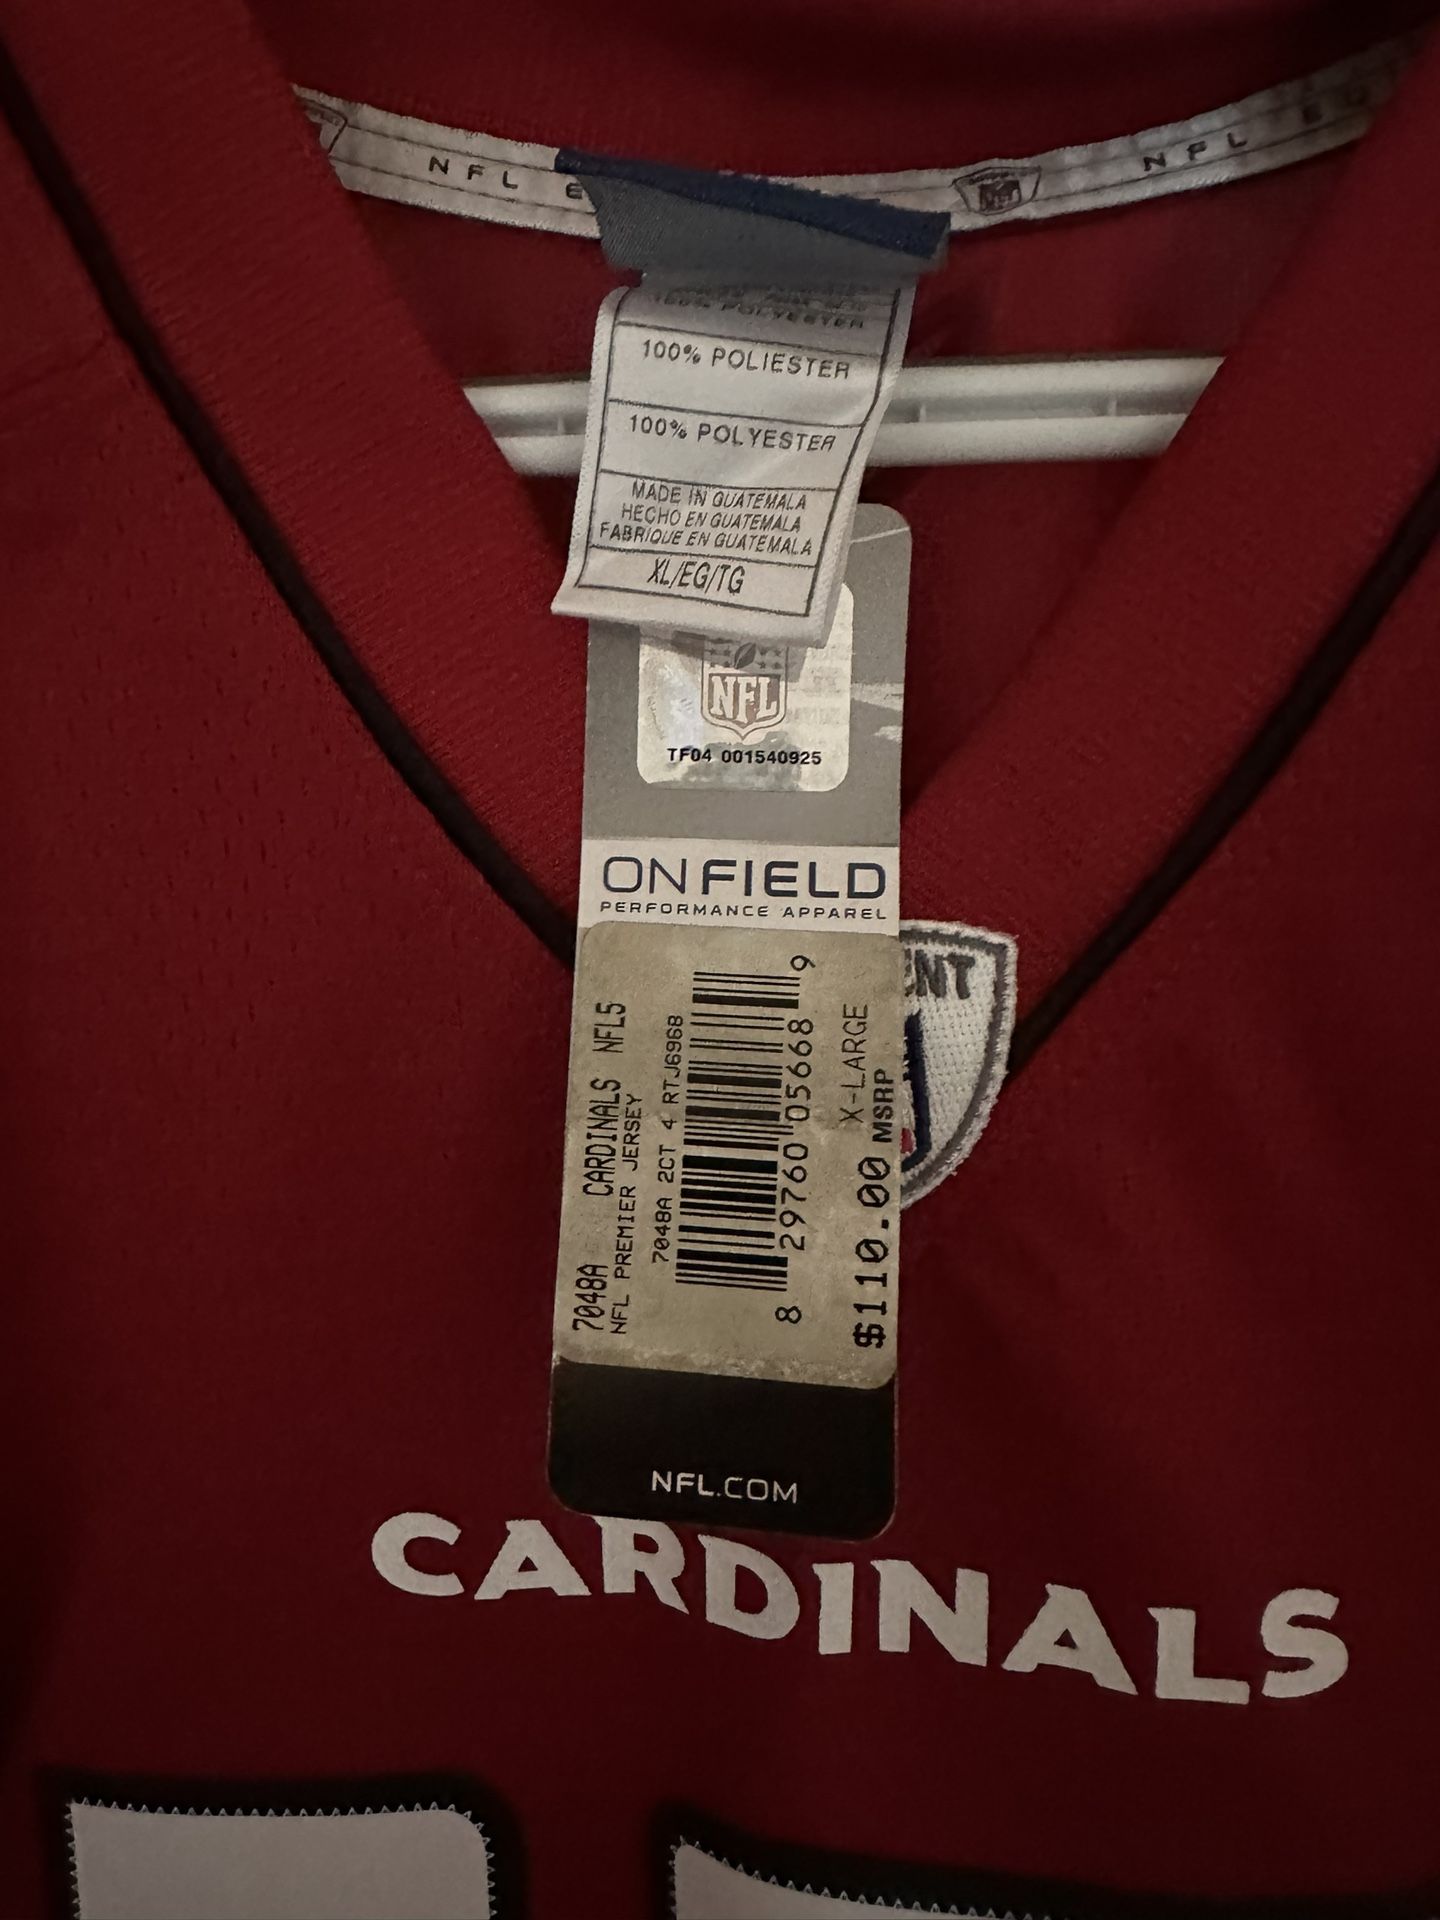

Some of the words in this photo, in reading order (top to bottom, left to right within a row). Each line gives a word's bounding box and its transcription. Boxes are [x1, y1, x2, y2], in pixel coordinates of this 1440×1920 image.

[427, 155, 519, 190] NFL
[642, 339, 702, 364] 100%
[711, 347, 850, 380] POLIESTER
[629, 414, 688, 440] 100%
[697, 422, 837, 451] POLYESTER
[632, 480, 682, 504] MADE
[688, 488, 706, 506] IN
[711, 491, 807, 511] GUATEMALA
[600, 520, 681, 546] FABRIQUE
[686, 530, 710, 547] EN
[713, 531, 813, 556] GUATEMALA
[621, 502, 682, 526] HECHO
[685, 510, 708, 527] EN
[709, 510, 801, 533] GUATEMALA
[646, 556, 747, 594] XL/EG/TG
[710, 676, 780, 723] NFL
[666, 747, 713, 763] TF04
[721, 750, 823, 765] 001540925
[599, 901, 770, 918] PERFORMANCE
[781, 905, 888, 920] APPAREL
[789, 954, 816, 972] 9
[661, 1014, 685, 1106] RTJ6968
[784, 1018, 815, 1123] 05668
[838, 1002, 869, 1124] X-LARGE
[582, 1076, 623, 1198] CARDINALS
[622, 1091, 645, 1172] JERSEY
[663, 1117, 678, 1131] 4
[657, 1144, 676, 1185] 2CT
[778, 1142, 810, 1252] 29760
[852, 1155, 891, 1350] $110.00
[872, 1067, 895, 1144] MSRP
[613, 1185, 638, 1281] PREMIER
[651, 1196, 674, 1266] 7048A
[572, 1263, 609, 1332] 7048A
[609, 1293, 631, 1335] NFL
[774, 1305, 802, 1325] 8
[650, 1470, 799, 1505] NFL.COM
[370, 1511, 1350, 1706] CARDINALS
